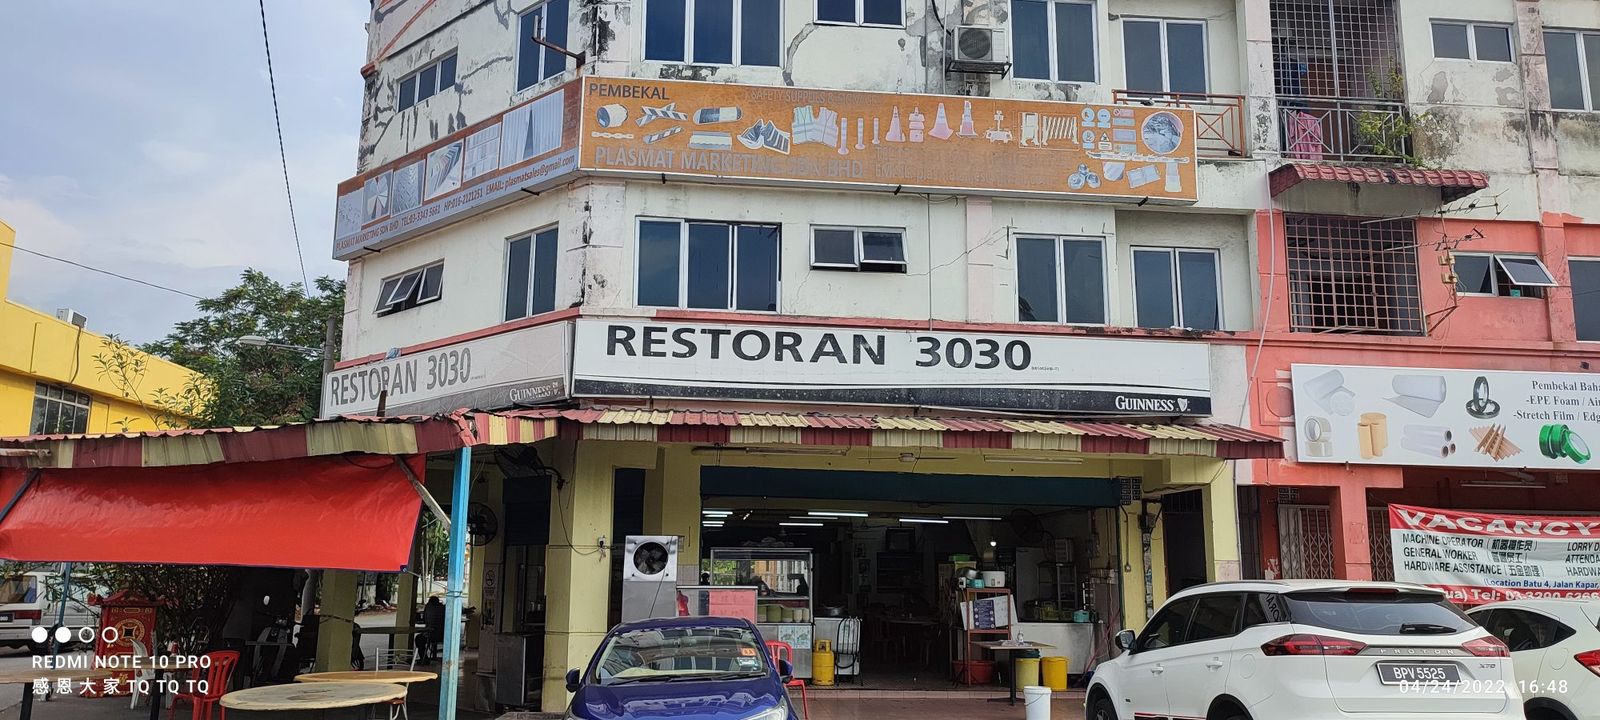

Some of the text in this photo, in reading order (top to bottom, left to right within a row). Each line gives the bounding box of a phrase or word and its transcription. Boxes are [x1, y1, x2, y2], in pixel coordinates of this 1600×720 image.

[589, 83, 670, 100] PEMBEKAL
[595, 147, 673, 169] PLASMAT
[680, 152, 782, 175] MARKETING
[825, 160, 864, 178] BHD
[606, 325, 1032, 371] RESTORAN 3030
[331, 347, 472, 407] RESTORAN 3030
[1532, 380, 1578, 391] Pembekal
[509, 384, 551, 403] GUINNESS
[1526, 395, 1551, 405] -EPE
[1553, 396, 1580, 405] Foam
[1115, 396, 1175, 411] GUINNESS
[1513, 410, 1550, 420] -Stretch
[1553, 411, 1575, 420] Film
[1397, 509, 1600, 536] VACANCY
[1402, 533, 1440, 545] MACHINE
[1441, 536, 1484, 548] OPERATOR
[1567, 541, 1593, 551] LORRY
[1403, 547, 1442, 558] GENERAL
[1444, 549, 1477, 560] WORKER
[1404, 561, 1450, 572] HARDWARE
[1453, 563, 1502, 575] ASSISTANCE
[1553, 580, 1574, 588] Jalan
[1445, 588, 1468, 602] ua)
[1471, 589, 1501, 601] Tel:
[1393, 667, 1446, 680] BPV 5525
